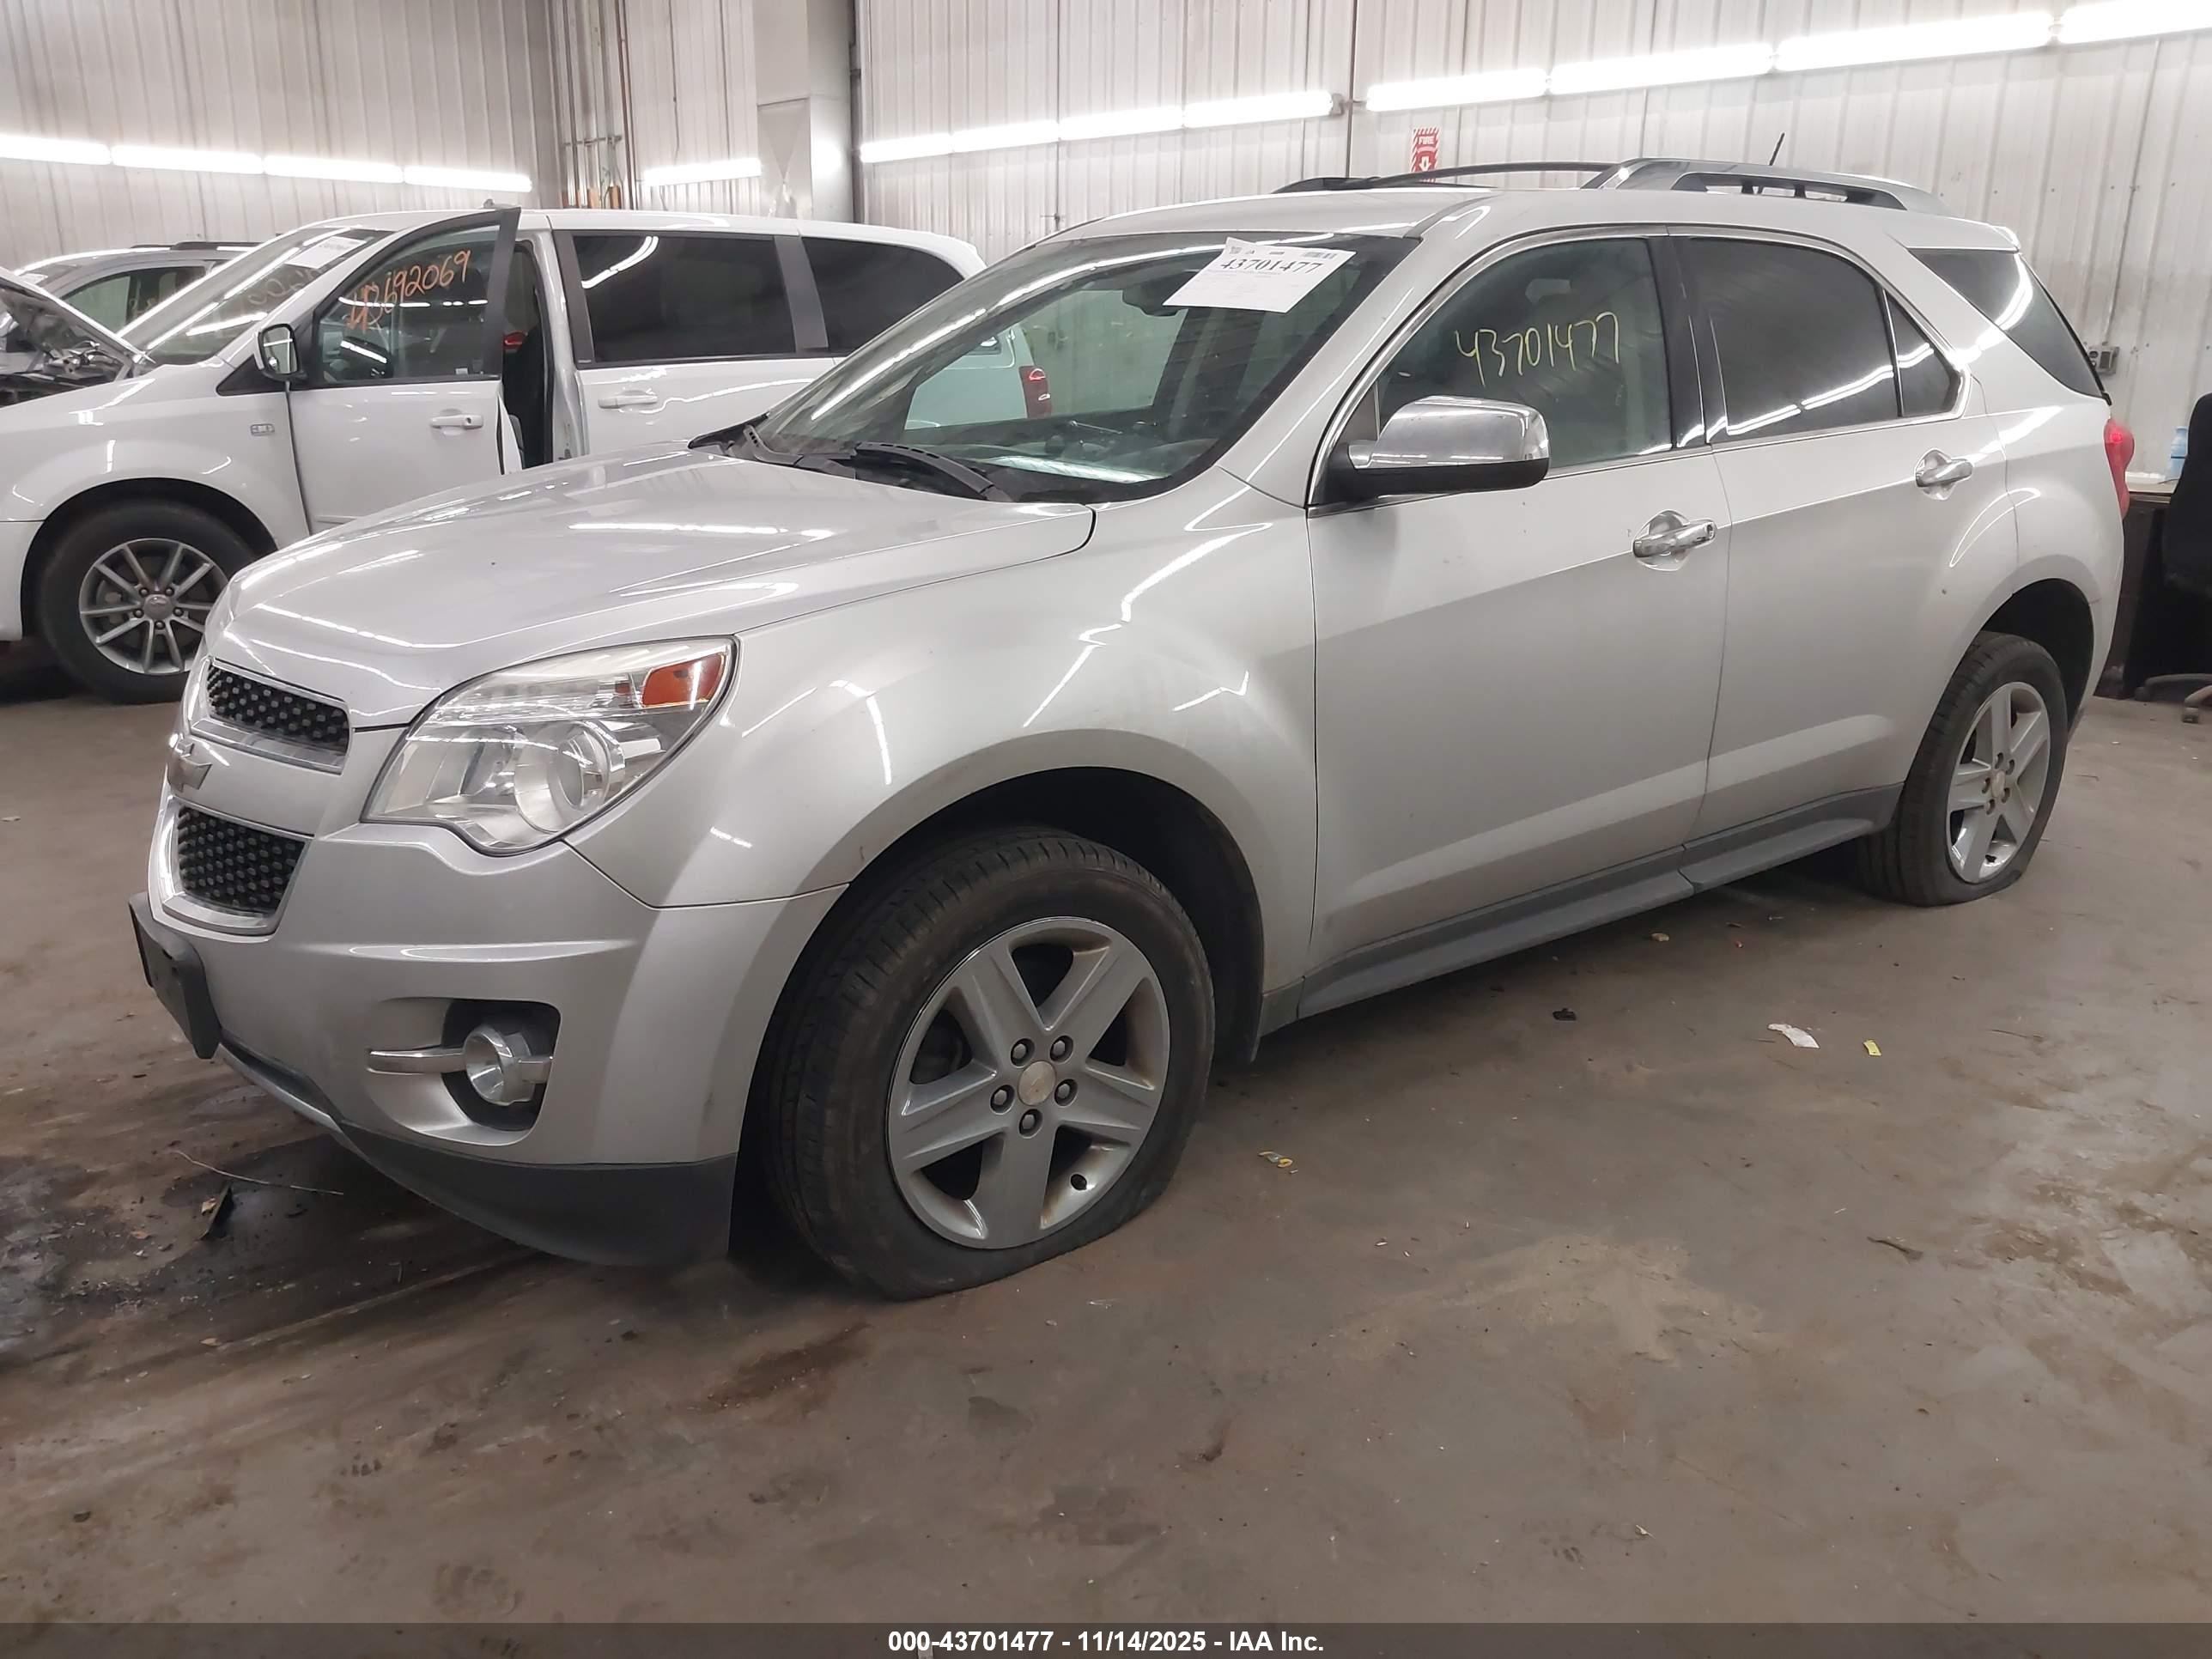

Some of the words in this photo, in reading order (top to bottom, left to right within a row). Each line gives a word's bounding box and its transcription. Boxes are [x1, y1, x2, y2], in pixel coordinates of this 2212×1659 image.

[1418, 136, 1435, 145] FIRE
[1220, 258, 1324, 275] 43701477
[1455, 311, 1620, 387] 43701477
